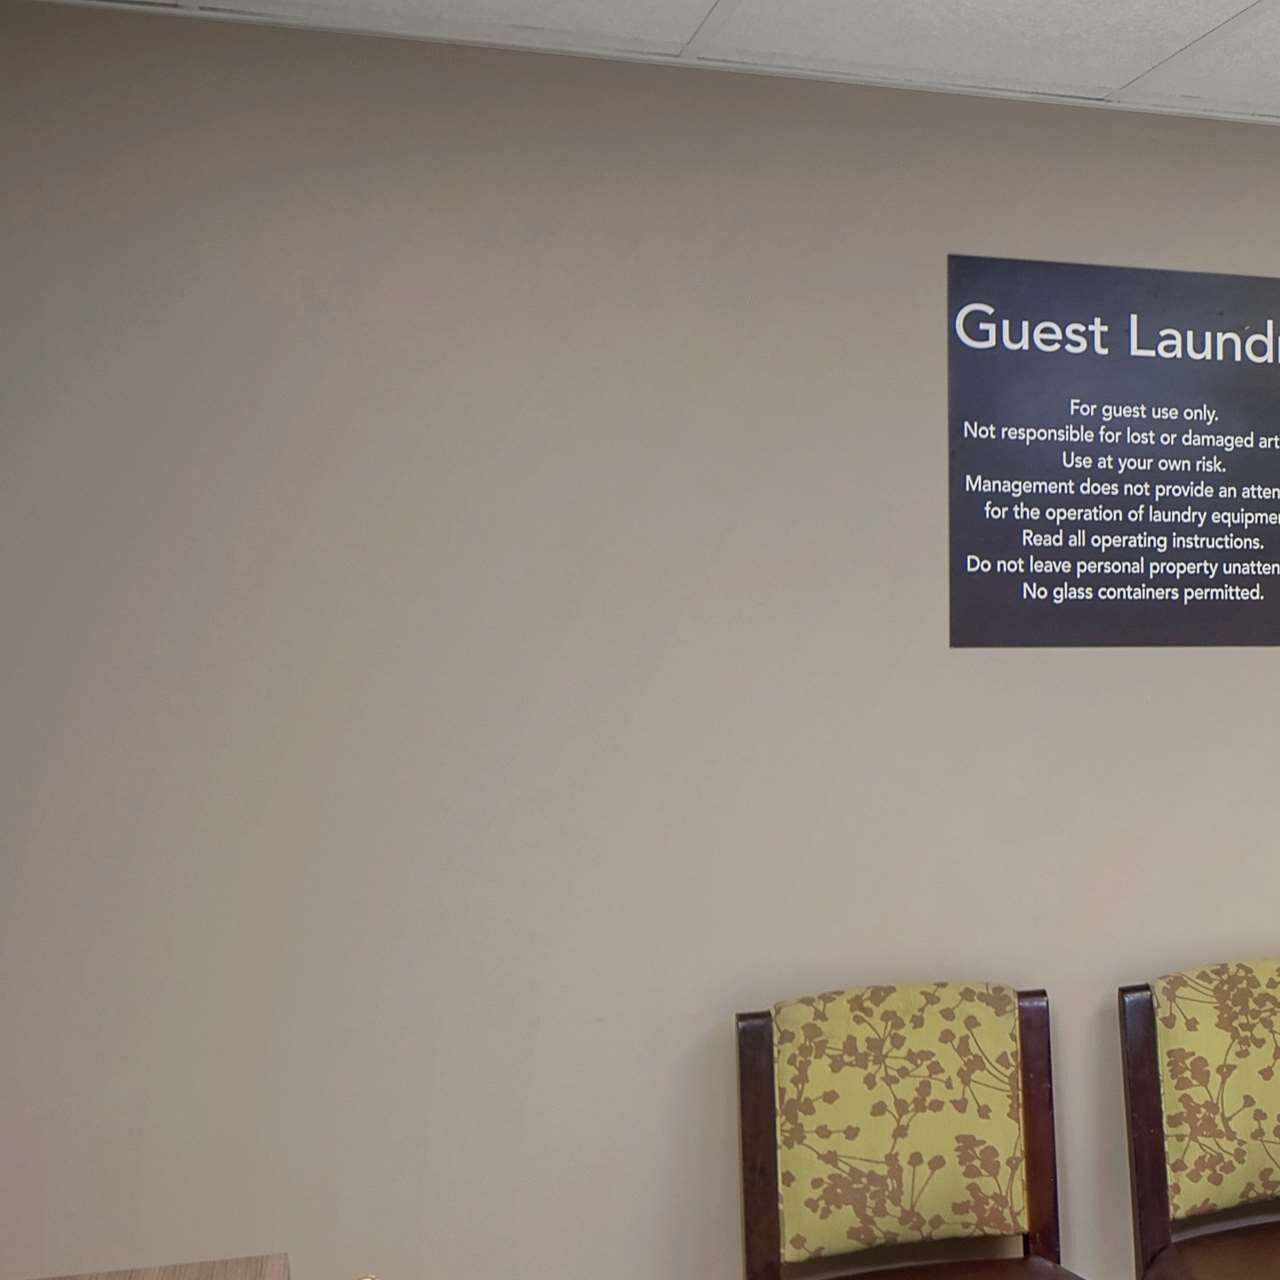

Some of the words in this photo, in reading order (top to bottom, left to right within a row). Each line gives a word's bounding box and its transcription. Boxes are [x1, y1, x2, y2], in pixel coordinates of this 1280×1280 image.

[956, 303, 1108, 355] Guest
[1071, 399, 1097, 416] For
[1102, 404, 1146, 421] guest
[1152, 408, 1178, 419] use
[1184, 404, 1218, 425] only.
[964, 421, 995, 439] Not
[1002, 424, 1094, 445] responsible
[1099, 425, 1121, 443] for
[1127, 427, 1155, 444] lost
[1160, 433, 1177, 445] or
[1182, 429, 1253, 451] damaged
[1063, 451, 1092, 468] Use
[1098, 455, 1113, 469] at
[1118, 458, 1153, 474] your
[1158, 459, 1190, 471] own
[1196, 456, 1226, 472] risk.
[966, 475, 1074, 497] Management
[1080, 477, 1118, 495] does
[1124, 482, 1150, 496] not
[1156, 481, 1214, 501] provide
[1219, 487, 1236, 498] an
[984, 501, 1008, 519] for
[1013, 502, 1040, 519] the
[1046, 505, 1122, 525] operation
[1128, 504, 1144, 521] of
[1150, 505, 1207, 527] laundry
[1023, 529, 1063, 546] Read
[1069, 530, 1085, 546] all
[1091, 532, 1167, 552] operating
[1173, 532, 1264, 549] instructions.
[967, 555, 991, 572] Do
[997, 558, 1024, 572] not
[1030, 555, 1071, 573] leave
[1077, 557, 1144, 578] personal
[1150, 560, 1218, 579] property
[1024, 583, 1047, 599] No
[1053, 582, 1093, 603] glass
[1098, 584, 1179, 599] containers
[1184, 584, 1264, 605] permitted.
